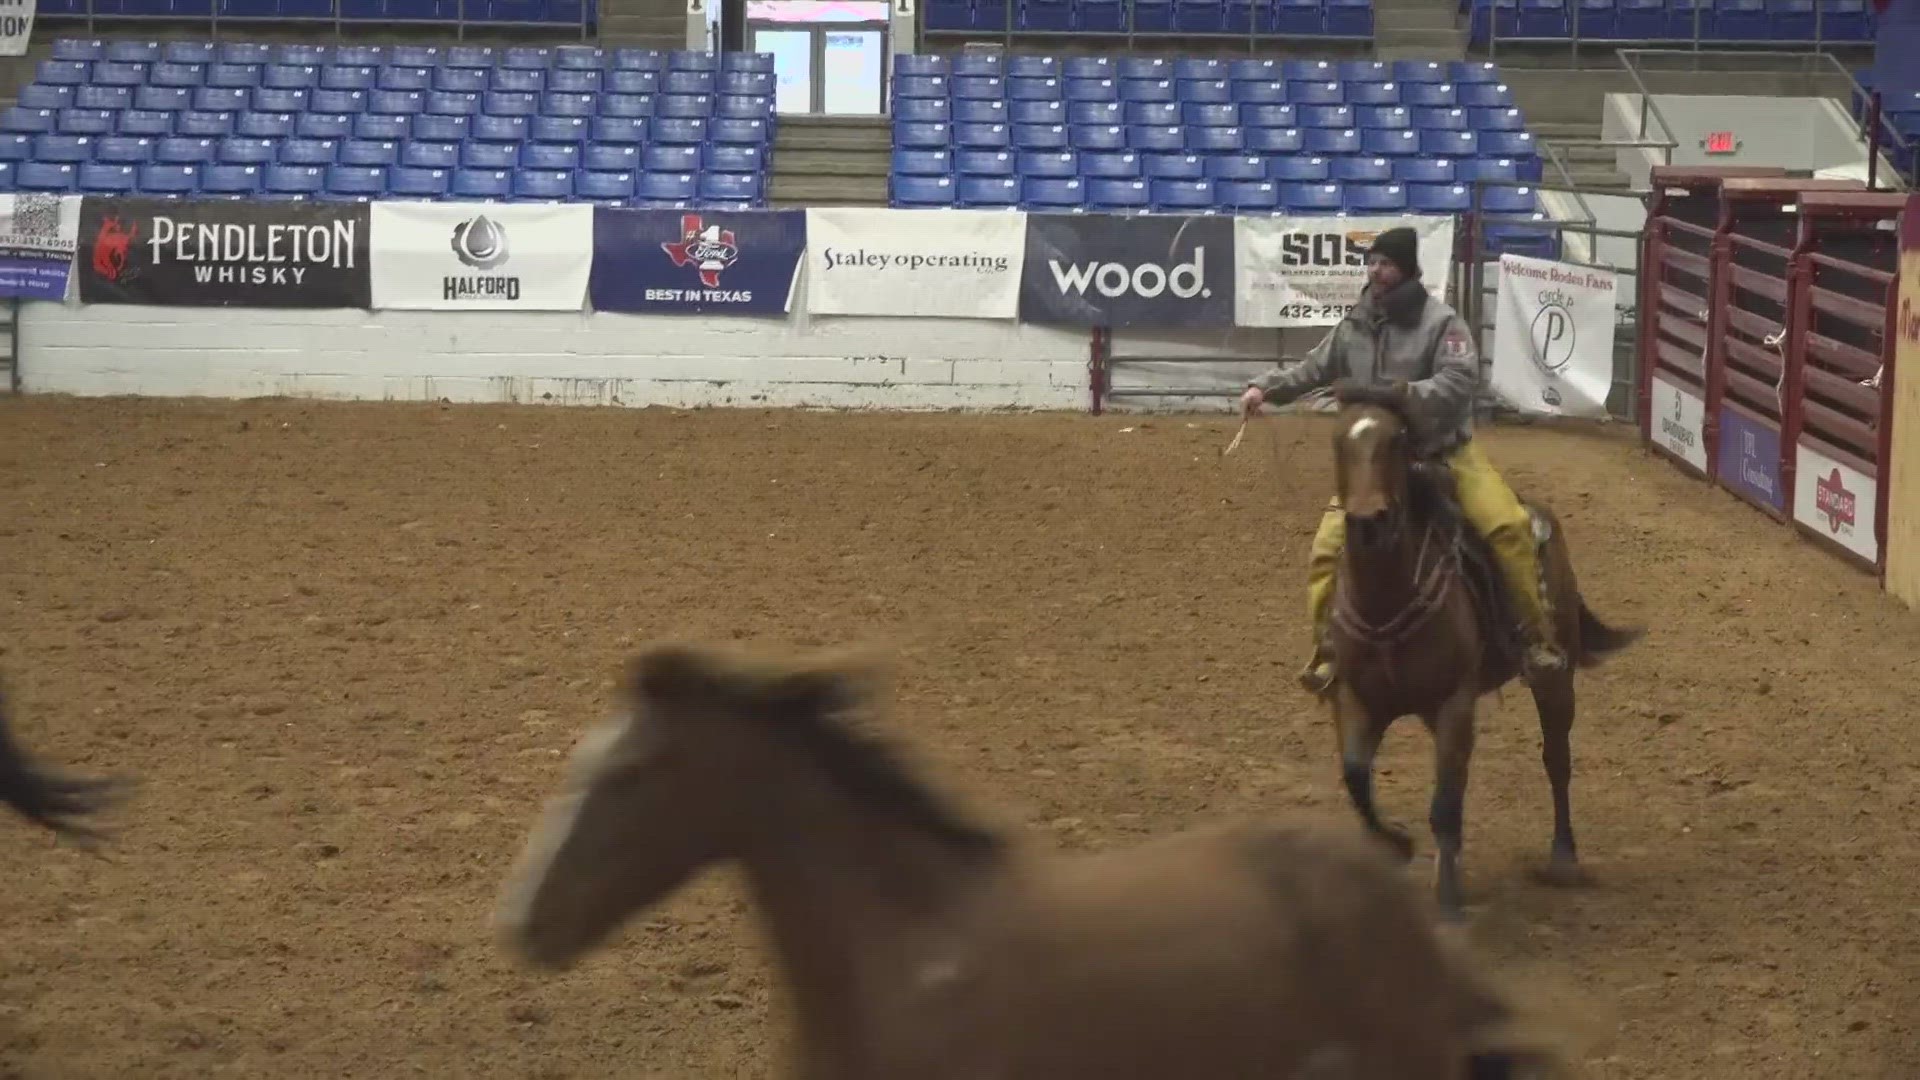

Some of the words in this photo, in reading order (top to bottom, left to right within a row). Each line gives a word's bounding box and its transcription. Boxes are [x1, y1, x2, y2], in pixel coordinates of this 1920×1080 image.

[1709, 132, 1732, 151] EXIT
[147, 216, 355, 268] PENDLETON
[1282, 233, 1368, 266] SOS
[824, 247, 891, 270] Staley
[895, 251, 1008, 272] operating
[1048, 246, 1212, 298] wood.
[194, 266, 306, 285] WHISKY
[443, 276, 520, 300] HALFORD
[1503, 260, 1548, 281] Welcome
[1550, 267, 1583, 286] Rodeo
[1585, 273, 1613, 290] Fans
[645, 289, 683, 301] BEST
[685, 290, 700, 302] IN
[703, 290, 752, 302] TEXAS
[1818, 484, 1855, 517] STANDARD
